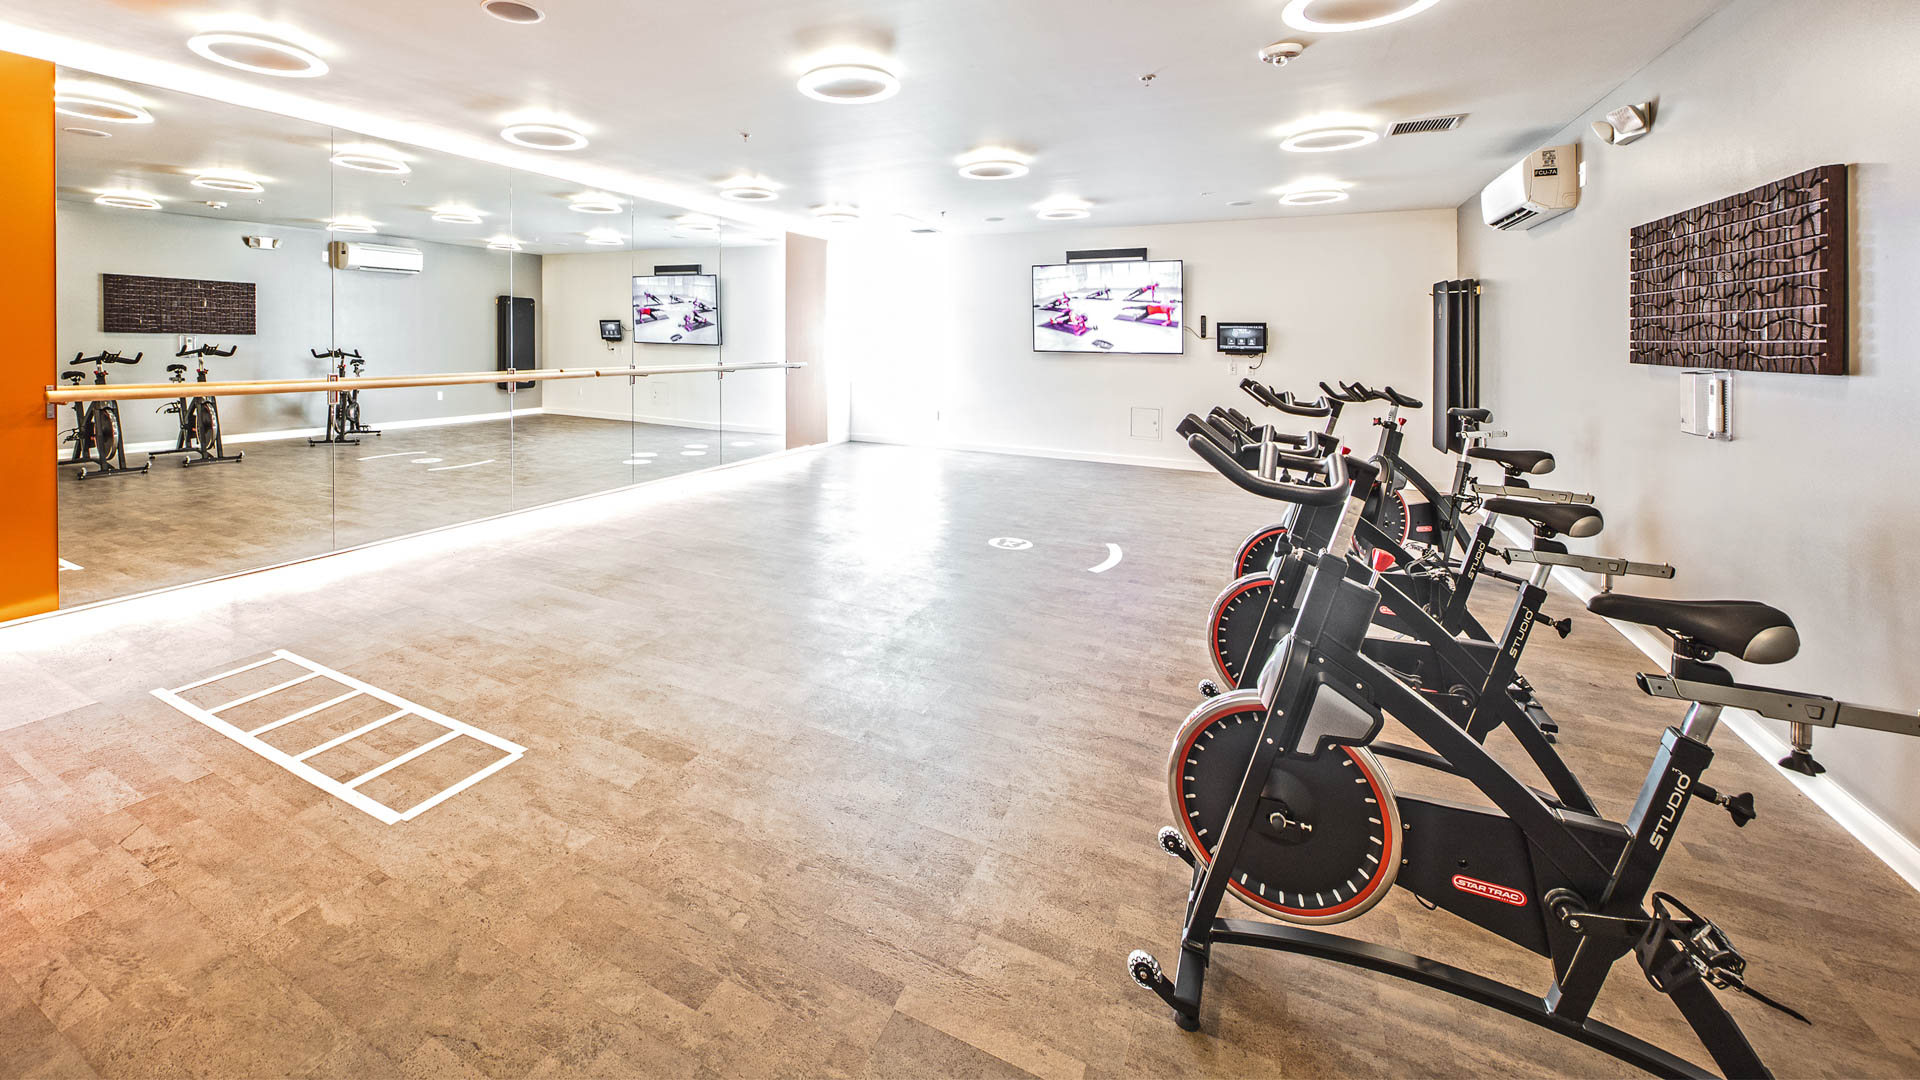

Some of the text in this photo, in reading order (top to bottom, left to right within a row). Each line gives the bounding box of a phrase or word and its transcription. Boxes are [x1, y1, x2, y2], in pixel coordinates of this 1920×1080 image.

[1467, 542, 1486, 580] STUDIO
[1508, 610, 1534, 659] STUDIO
[1649, 774, 1691, 851] STUDIO
[1458, 879, 1519, 901] STAR TRAC
